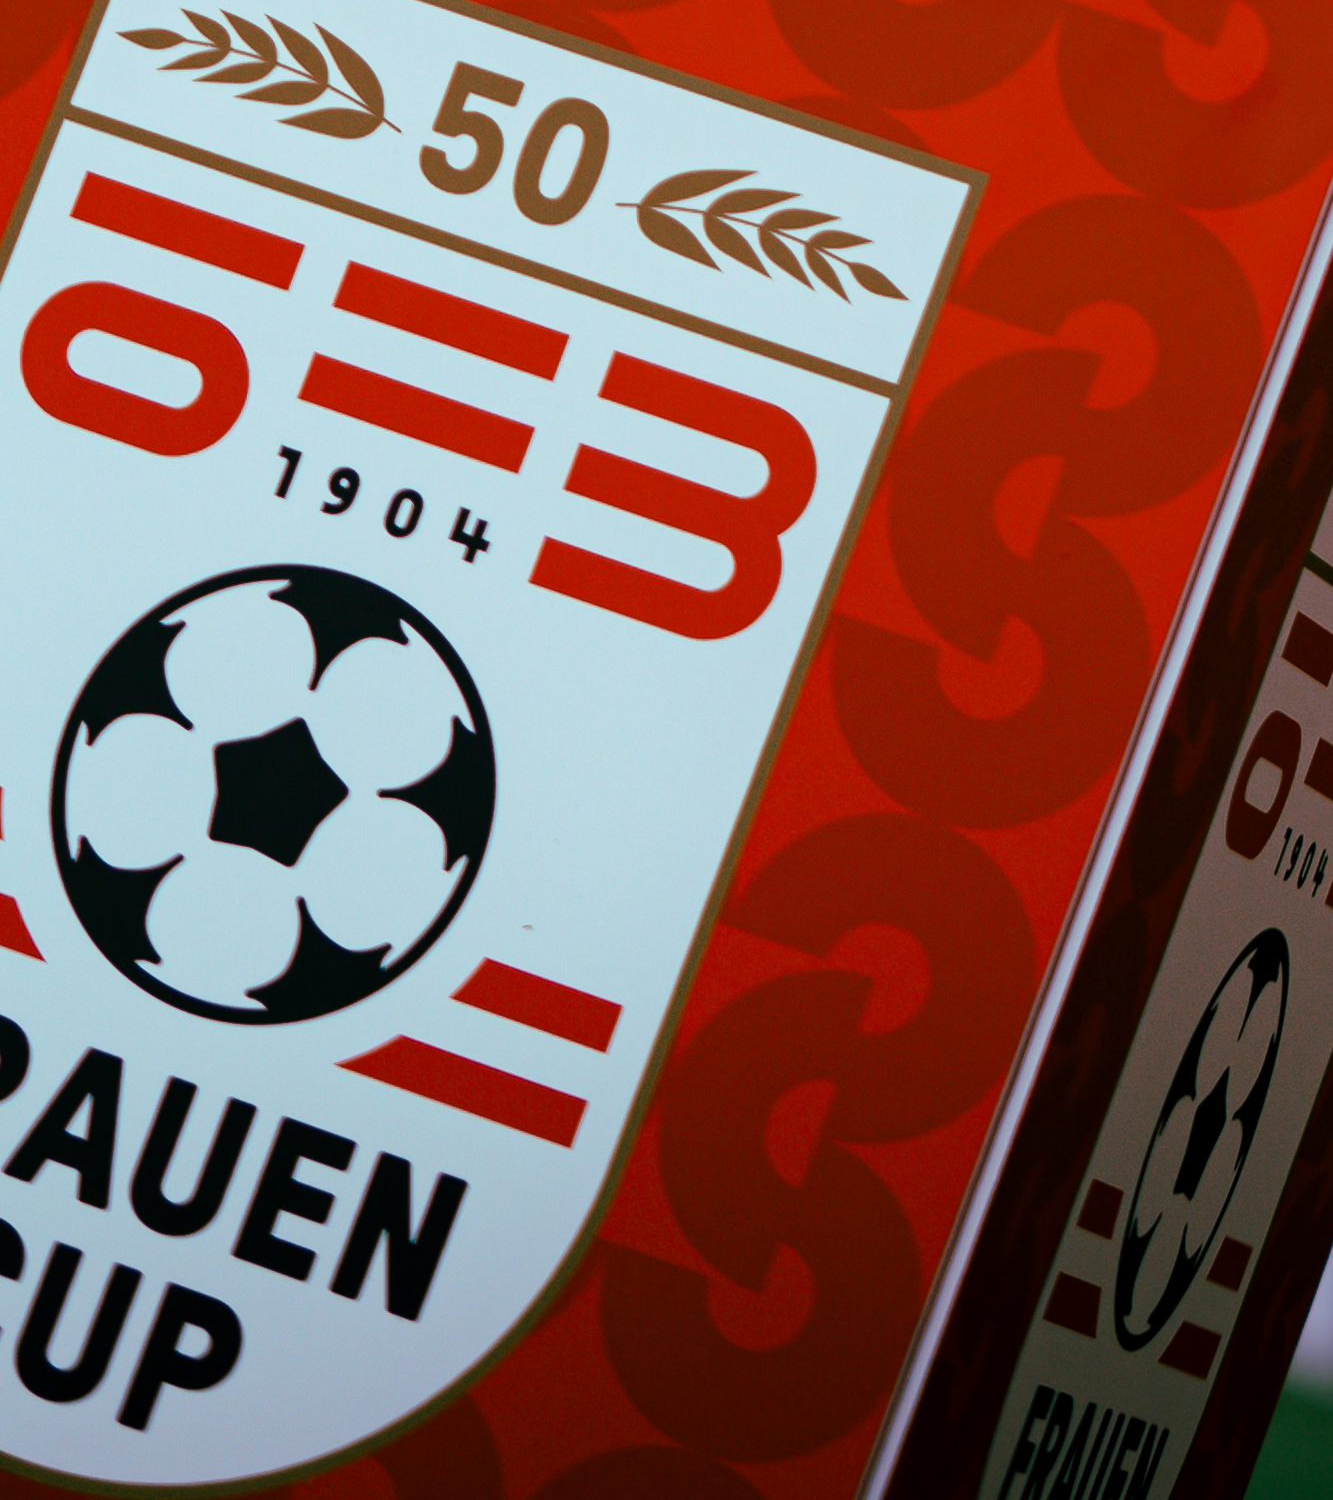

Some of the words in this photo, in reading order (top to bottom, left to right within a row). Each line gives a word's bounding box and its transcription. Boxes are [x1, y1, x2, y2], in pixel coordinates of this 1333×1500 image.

[419, 61, 610, 226] 50
[273, 444, 491, 564] 1904
[1273, 826, 1329, 898] 1904
[0, 1014, 469, 1322] AUEN
[996, 1384, 1171, 1500] FRAUEN
